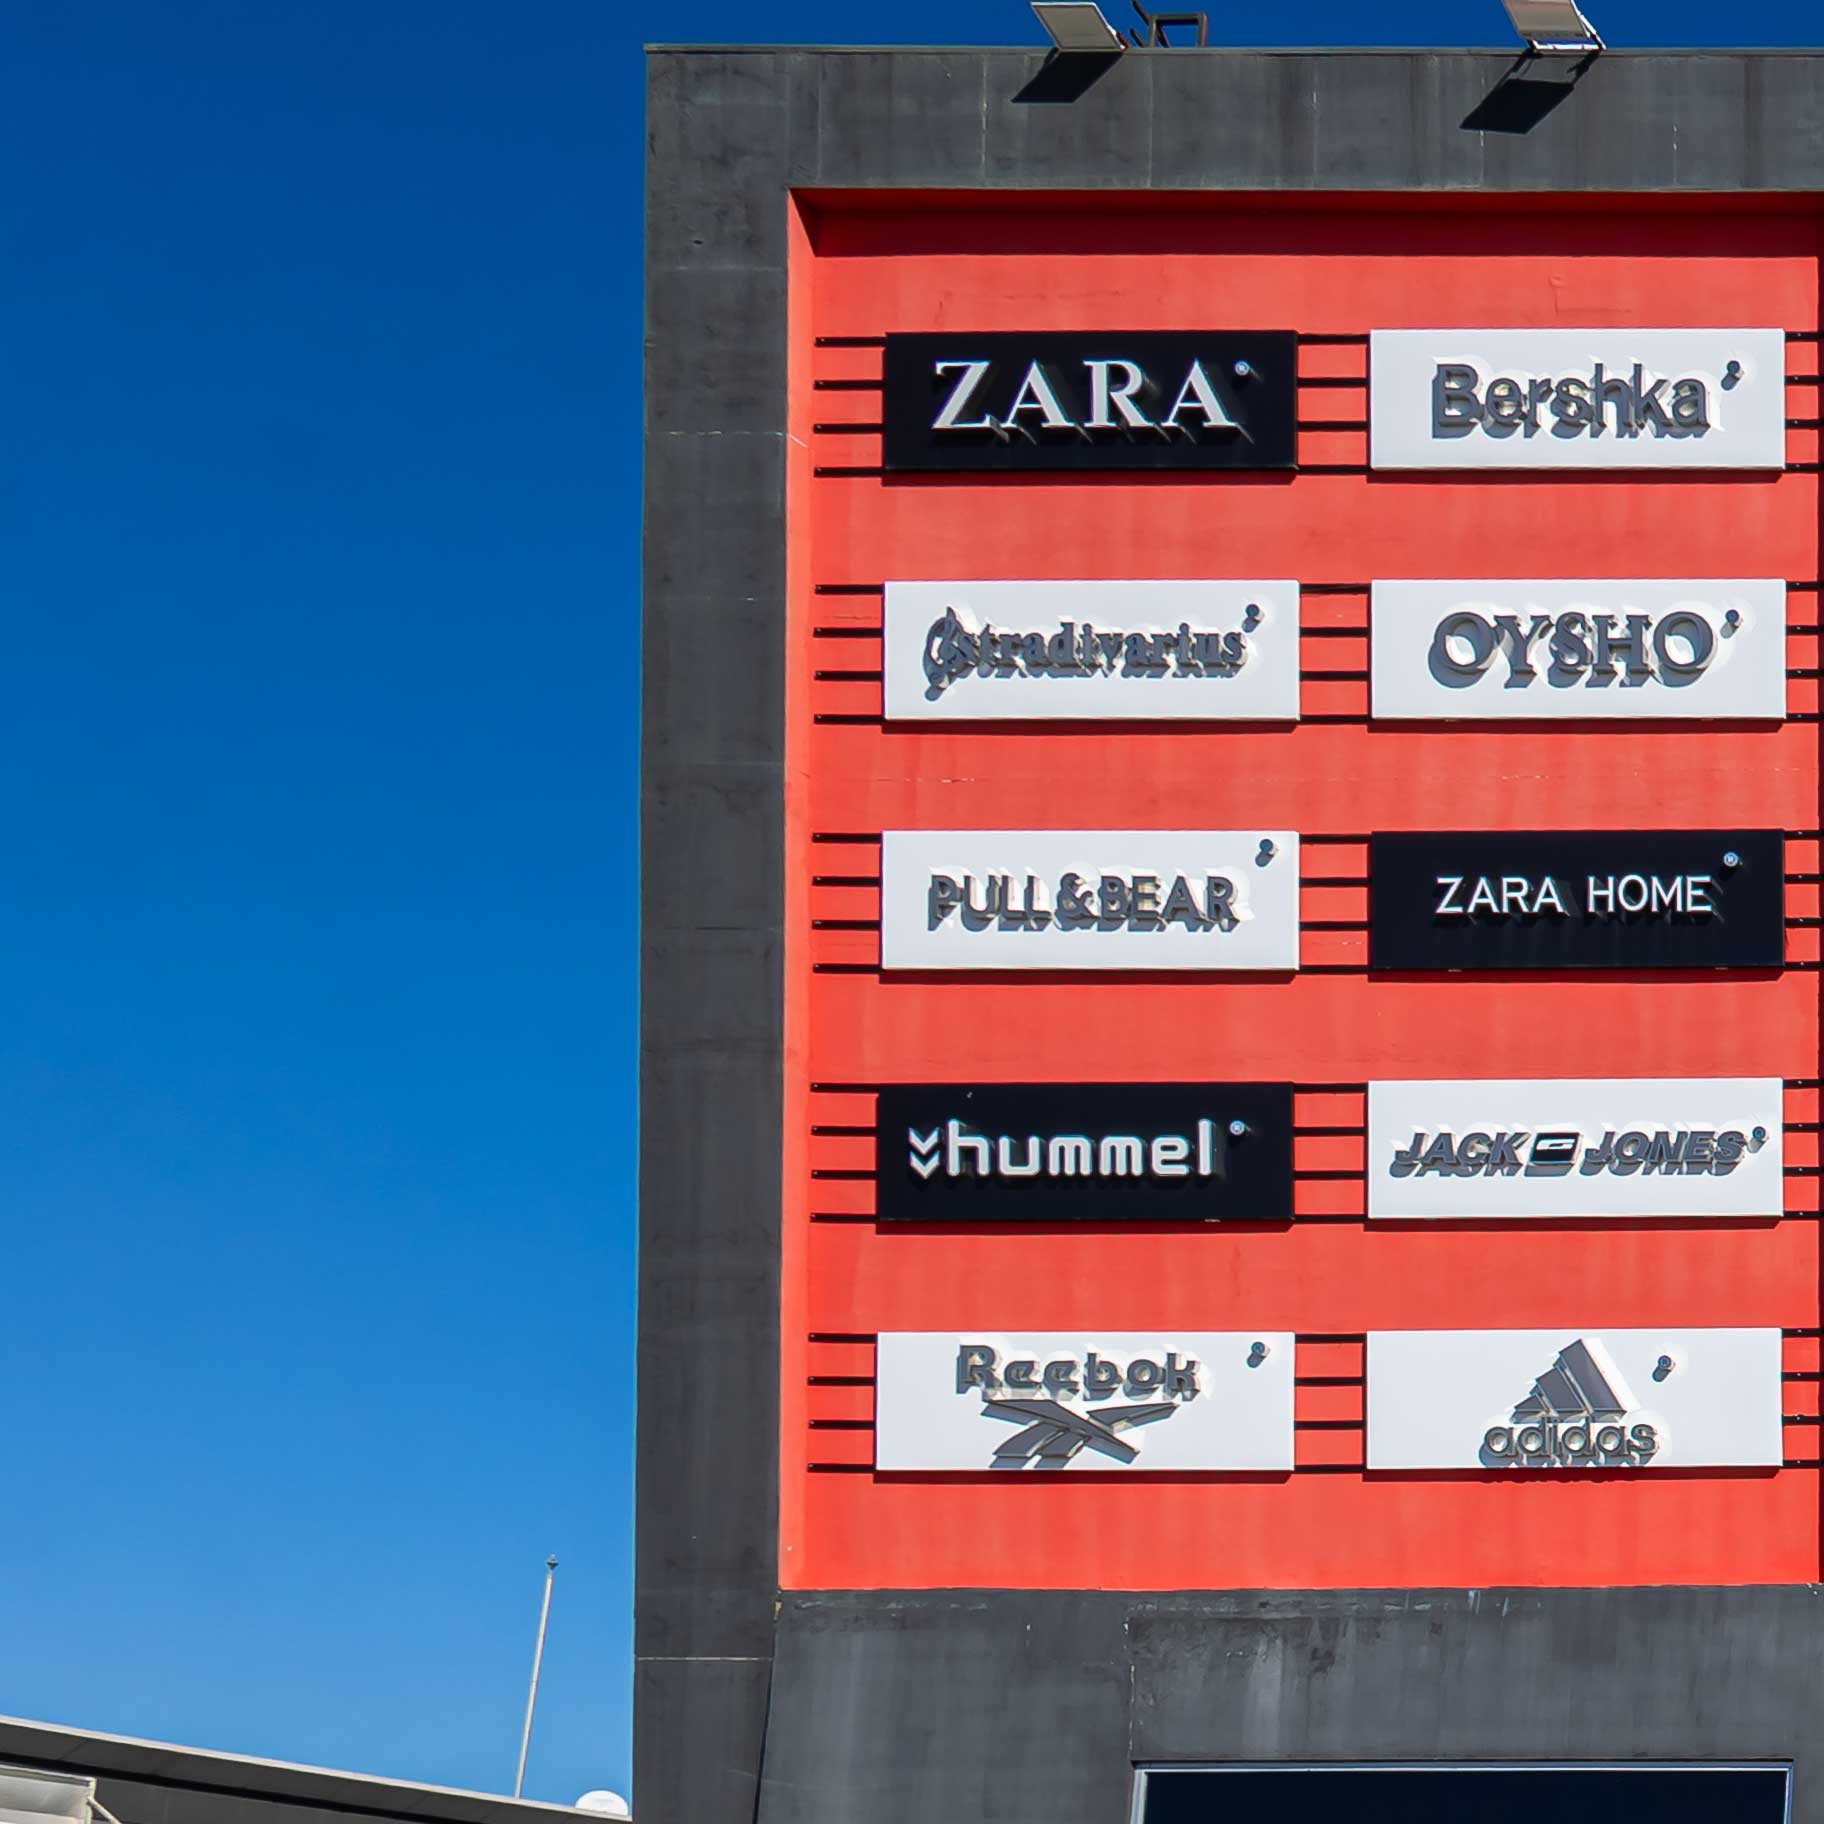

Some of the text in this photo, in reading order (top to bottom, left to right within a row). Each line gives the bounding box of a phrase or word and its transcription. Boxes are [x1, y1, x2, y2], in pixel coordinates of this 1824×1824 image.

[931, 360, 1239, 430] ZARA
[1435, 363, 1708, 430] Bershka
[1435, 612, 1717, 676] OYSHO
[929, 873, 1238, 926] PULL&BEAR
[1436, 876, 1713, 914] ZARA HOME
[947, 1120, 1212, 1178] hummel
[1395, 1130, 1742, 1169] JACK JONES
[958, 1345, 1200, 1396] Reebok
[1484, 1417, 1657, 1458] adidas
